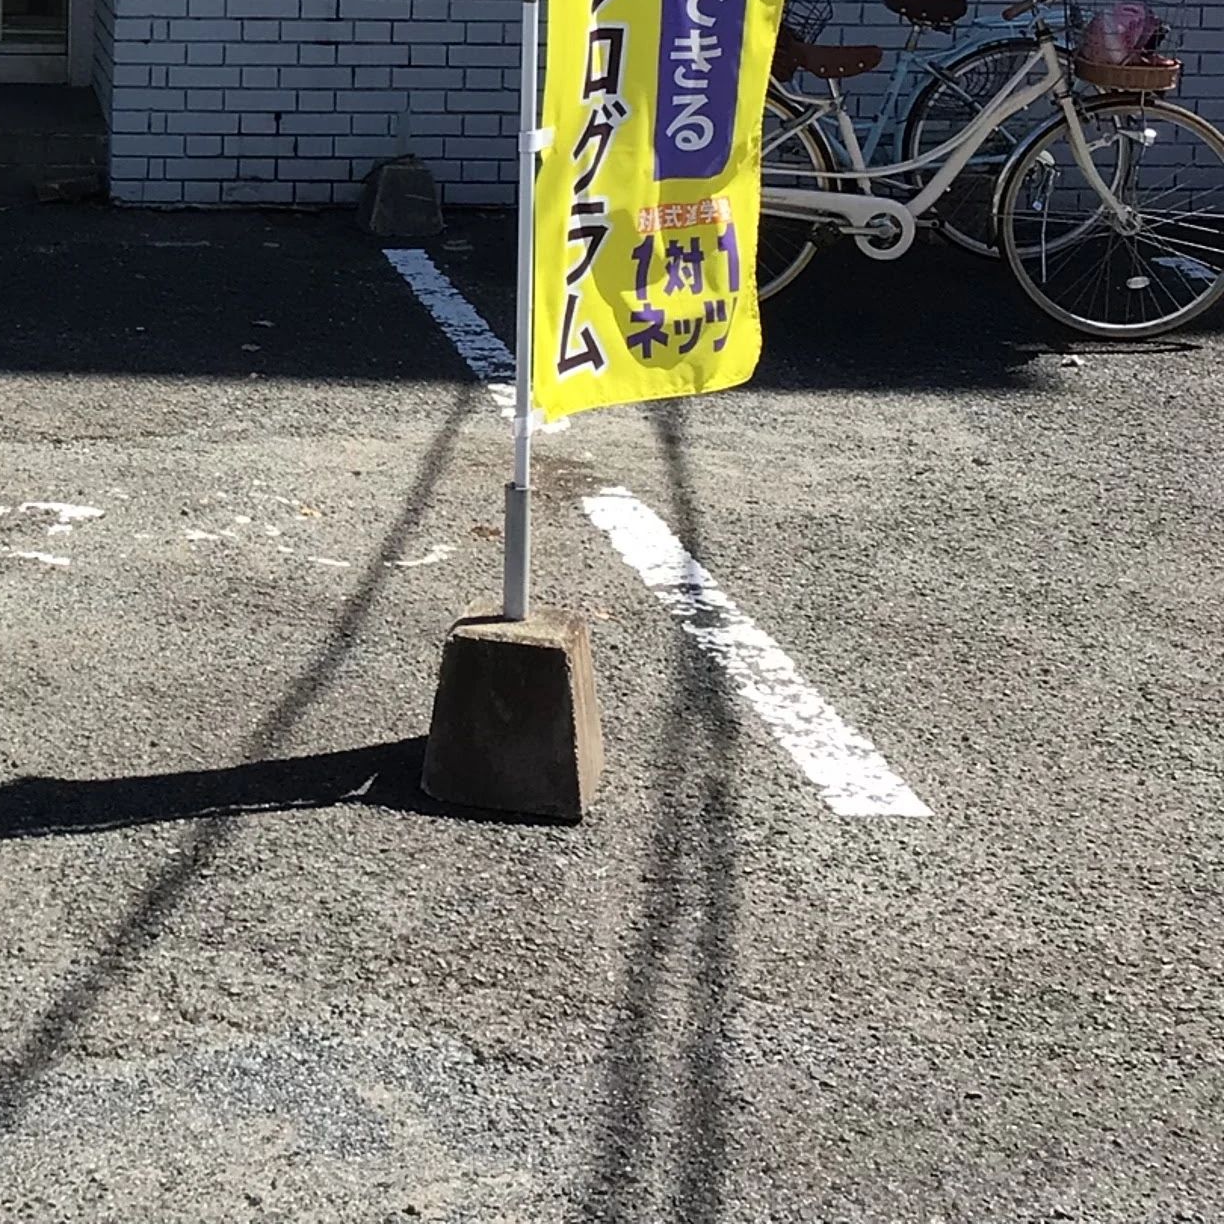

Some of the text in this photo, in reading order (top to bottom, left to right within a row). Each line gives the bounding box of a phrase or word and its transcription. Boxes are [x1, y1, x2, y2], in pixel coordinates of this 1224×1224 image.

[632, 222, 740, 301] 1対1
[627, 297, 738, 359] ネッツ
